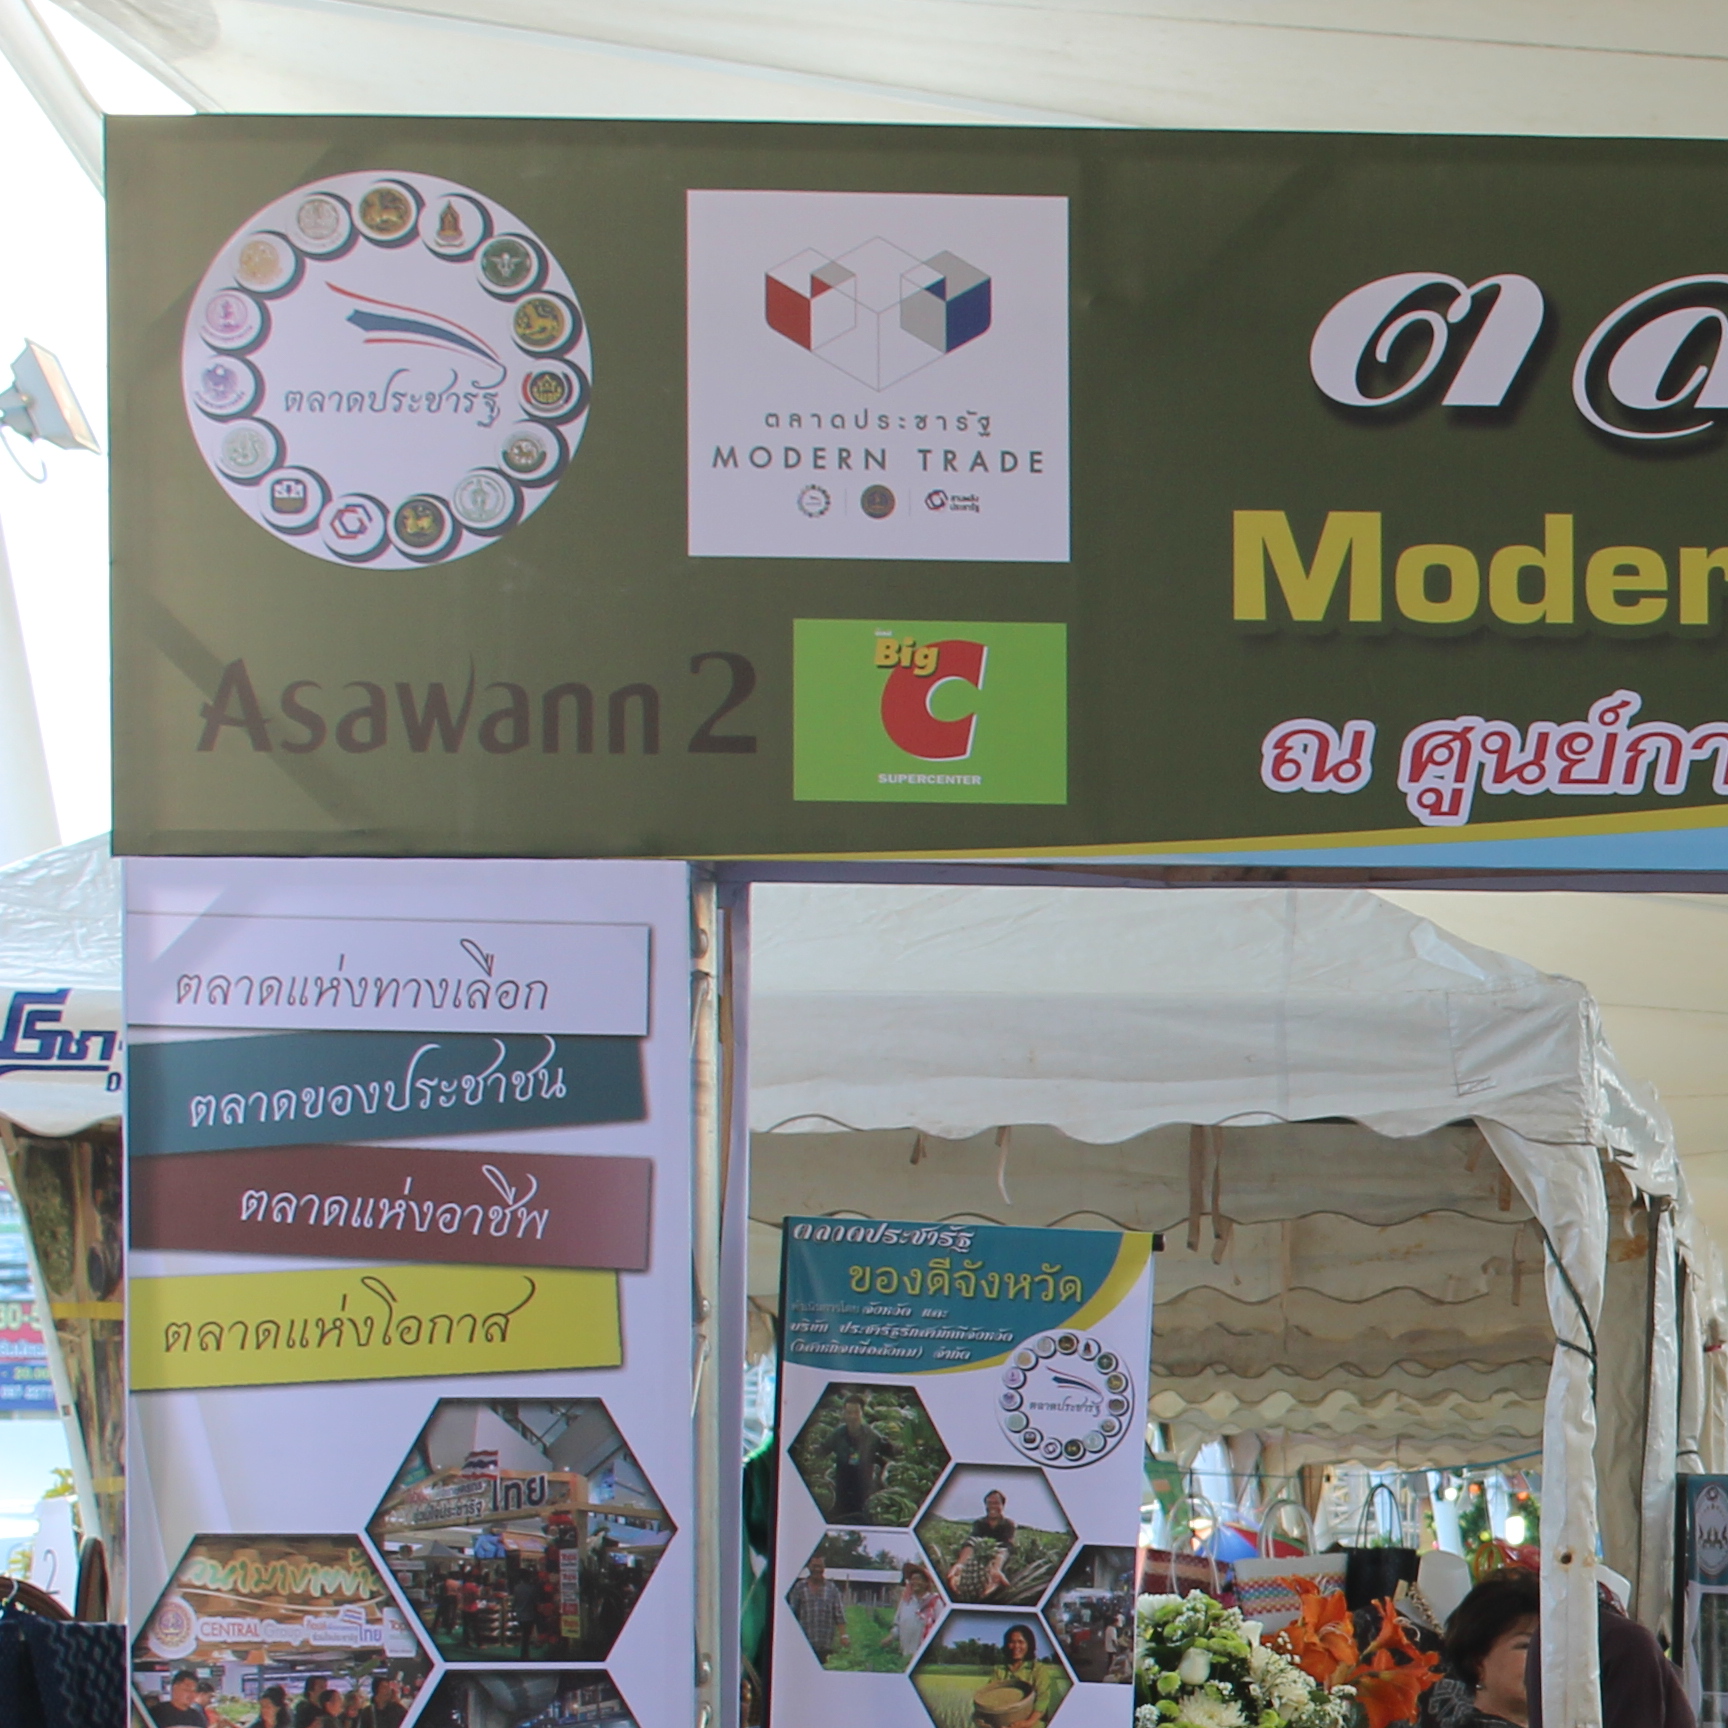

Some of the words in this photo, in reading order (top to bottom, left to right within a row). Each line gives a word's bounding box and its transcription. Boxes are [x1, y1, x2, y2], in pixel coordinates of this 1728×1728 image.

[283, 368, 502, 429] ตลาดประชารัฐ
[764, 406, 991, 438] ตลาดประชารัฐ
[712, 445, 888, 472] MODERN
[917, 447, 1045, 474] TRADE
[874, 637, 940, 677] Big
[197, 652, 661, 754] Asawann
[687, 651, 758, 754] 2
[880, 639, 988, 761] C
[878, 773, 982, 785] SUPERCENTER
[1266, 724, 1366, 790] ณ
[175, 938, 549, 1011] ตลาดแห่งทางเลือก
[190, 1035, 567, 1128] ตลาดของประชาชน
[240, 1165, 553, 1240] ตลาดแห่งอาชีพ
[793, 1222, 976, 1254] ตลาดประชารัฐ
[849, 1257, 1084, 1304] ของดีจังหวัด
[163, 1276, 535, 1353] ตลาดแห่งโอกาส
[200, 1620, 261, 1638] CENTRAL
